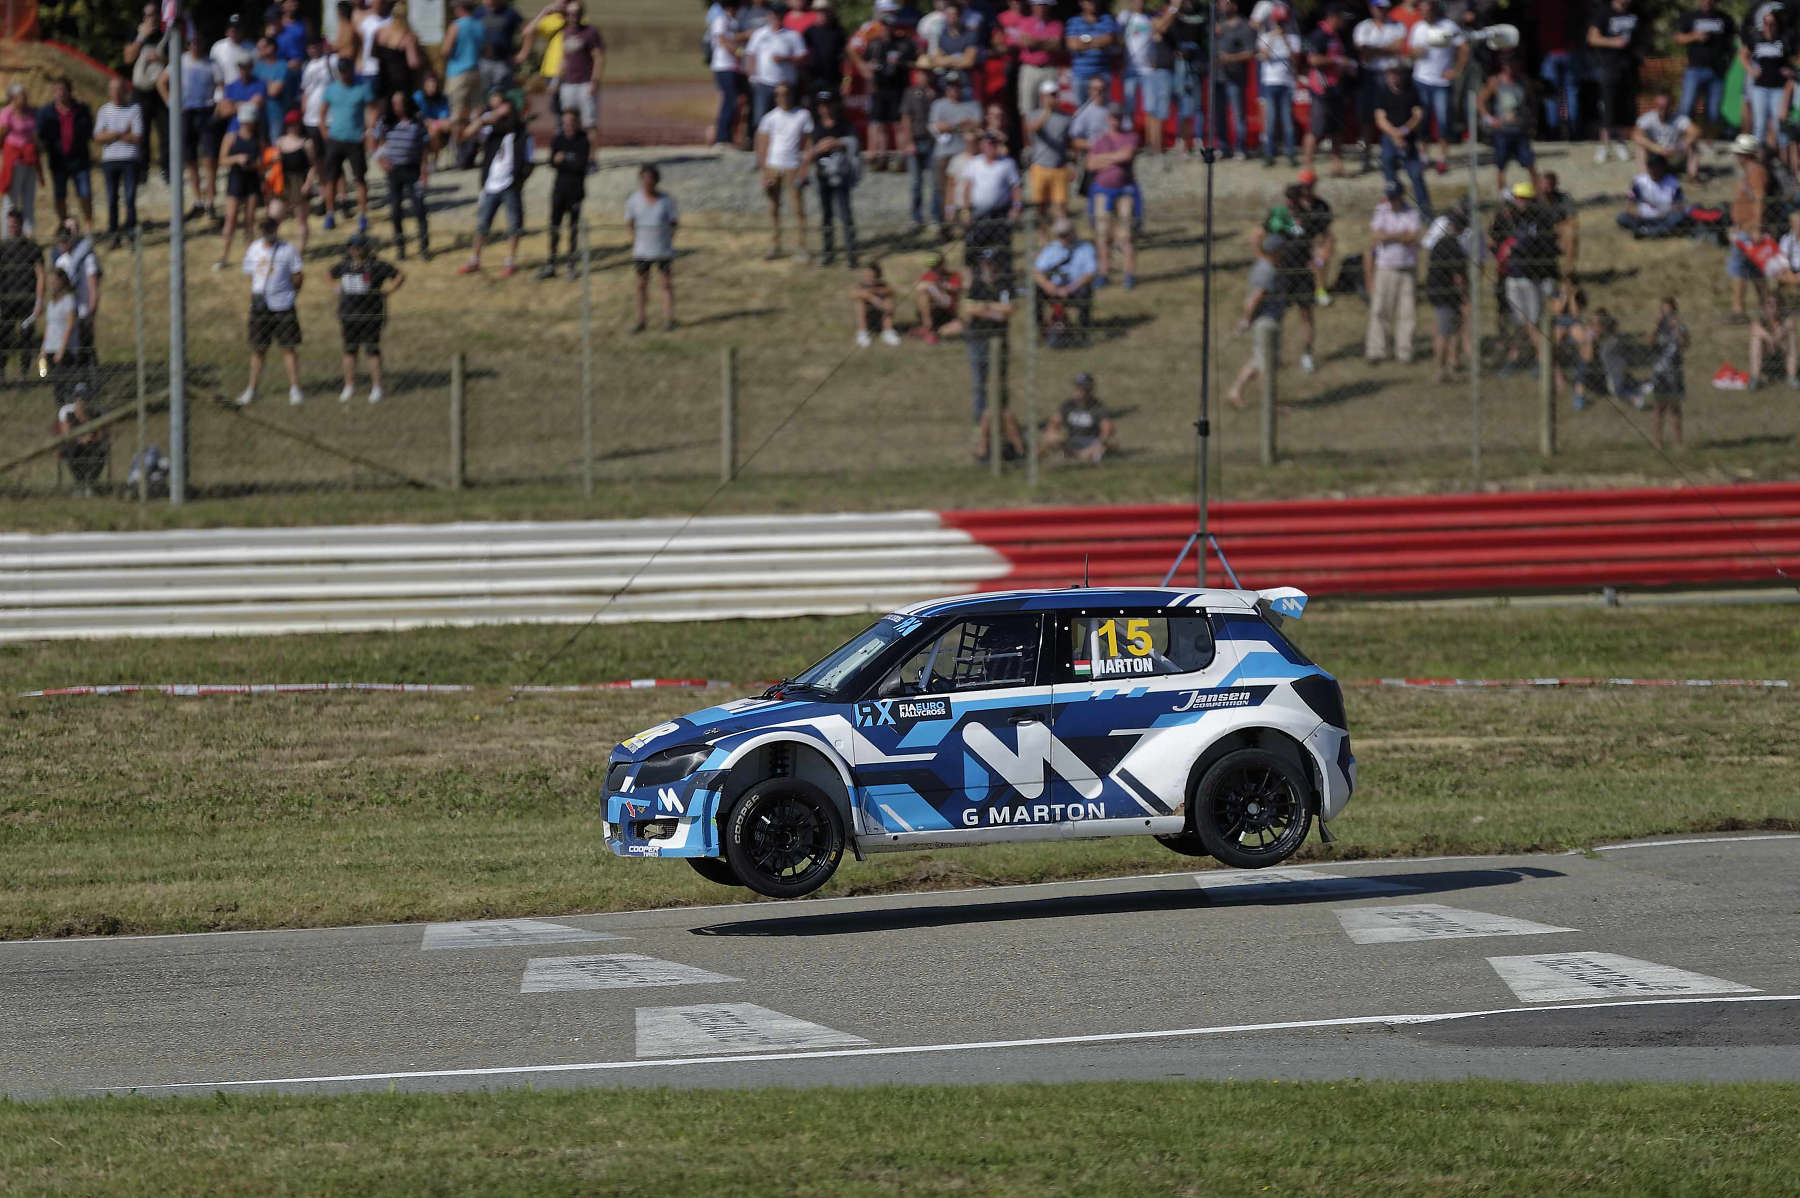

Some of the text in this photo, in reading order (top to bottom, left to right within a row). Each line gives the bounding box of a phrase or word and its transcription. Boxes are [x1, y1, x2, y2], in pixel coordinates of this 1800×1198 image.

[1098, 619, 1153, 657] 15
[1172, 690, 1251, 712] Jansen
[1193, 700, 1249, 709] COMPETITION
[899, 708, 946, 718] RALLYCROSS
[734, 794, 760, 844] COOPER
[962, 802, 1106, 826] G MARTON
[628, 845, 660, 854] COOPER
